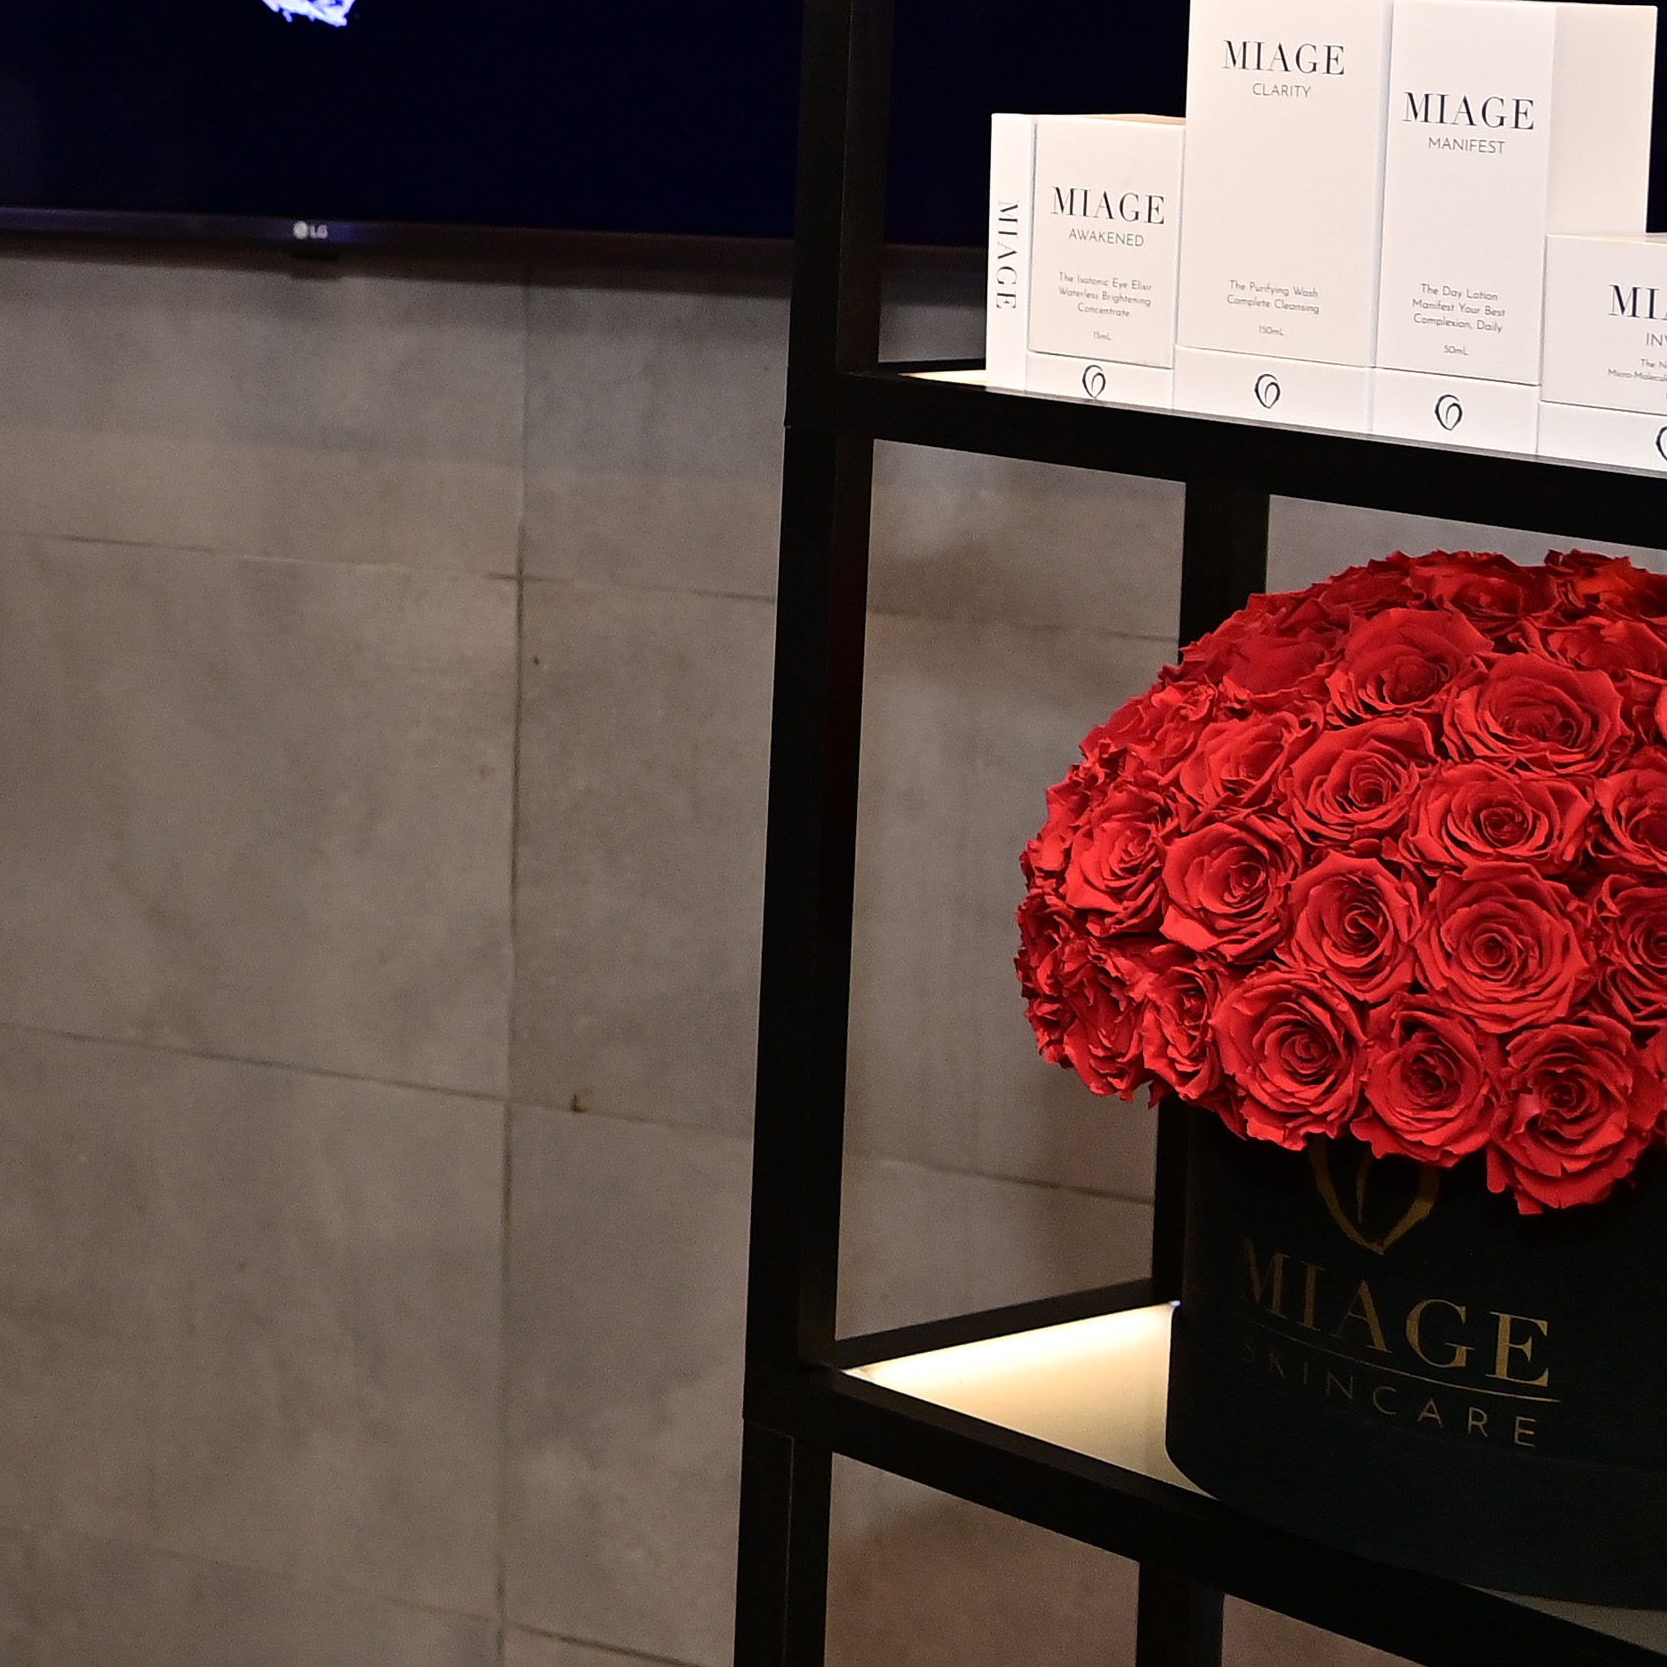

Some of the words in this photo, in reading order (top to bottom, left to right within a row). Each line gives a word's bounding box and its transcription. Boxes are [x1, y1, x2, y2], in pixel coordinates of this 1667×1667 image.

[1221, 39, 1345, 76] MIAGE
[1252, 82, 1312, 98] CLARITY
[1402, 91, 1535, 130] MIAGE
[1428, 136, 1506, 154] MANIFEST
[1050, 185, 1166, 225] MIAGE
[1068, 228, 1145, 247] AWAKENED
[995, 200, 1019, 309] MIAGE
[1058, 271, 1075, 283] The
[1112, 277, 1128, 289] Eye
[1131, 279, 1153, 291] Elixir
[1229, 279, 1246, 291] The
[1249, 281, 1290, 297] Purifying
[1293, 286, 1319, 298] Wash
[1058, 286, 1099, 300] Waterless
[1101, 291, 1152, 307] Brightening
[1420, 282, 1439, 295] The
[1442, 285, 1463, 299] Day
[1466, 288, 1498, 301] Lotion
[1077, 302, 1130, 318] Concentrate
[1226, 293, 1271, 308] Complete
[1273, 298, 1320, 315] Cleansing
[1412, 298, 1455, 312] Manifest
[1458, 302, 1481, 314] Your
[1484, 305, 1506, 317] Best
[1476, 319, 1503, 334] Daily
[1240, 1236, 1549, 1388] MIAGE
[1242, 1339, 1537, 1448] SKINCARE
